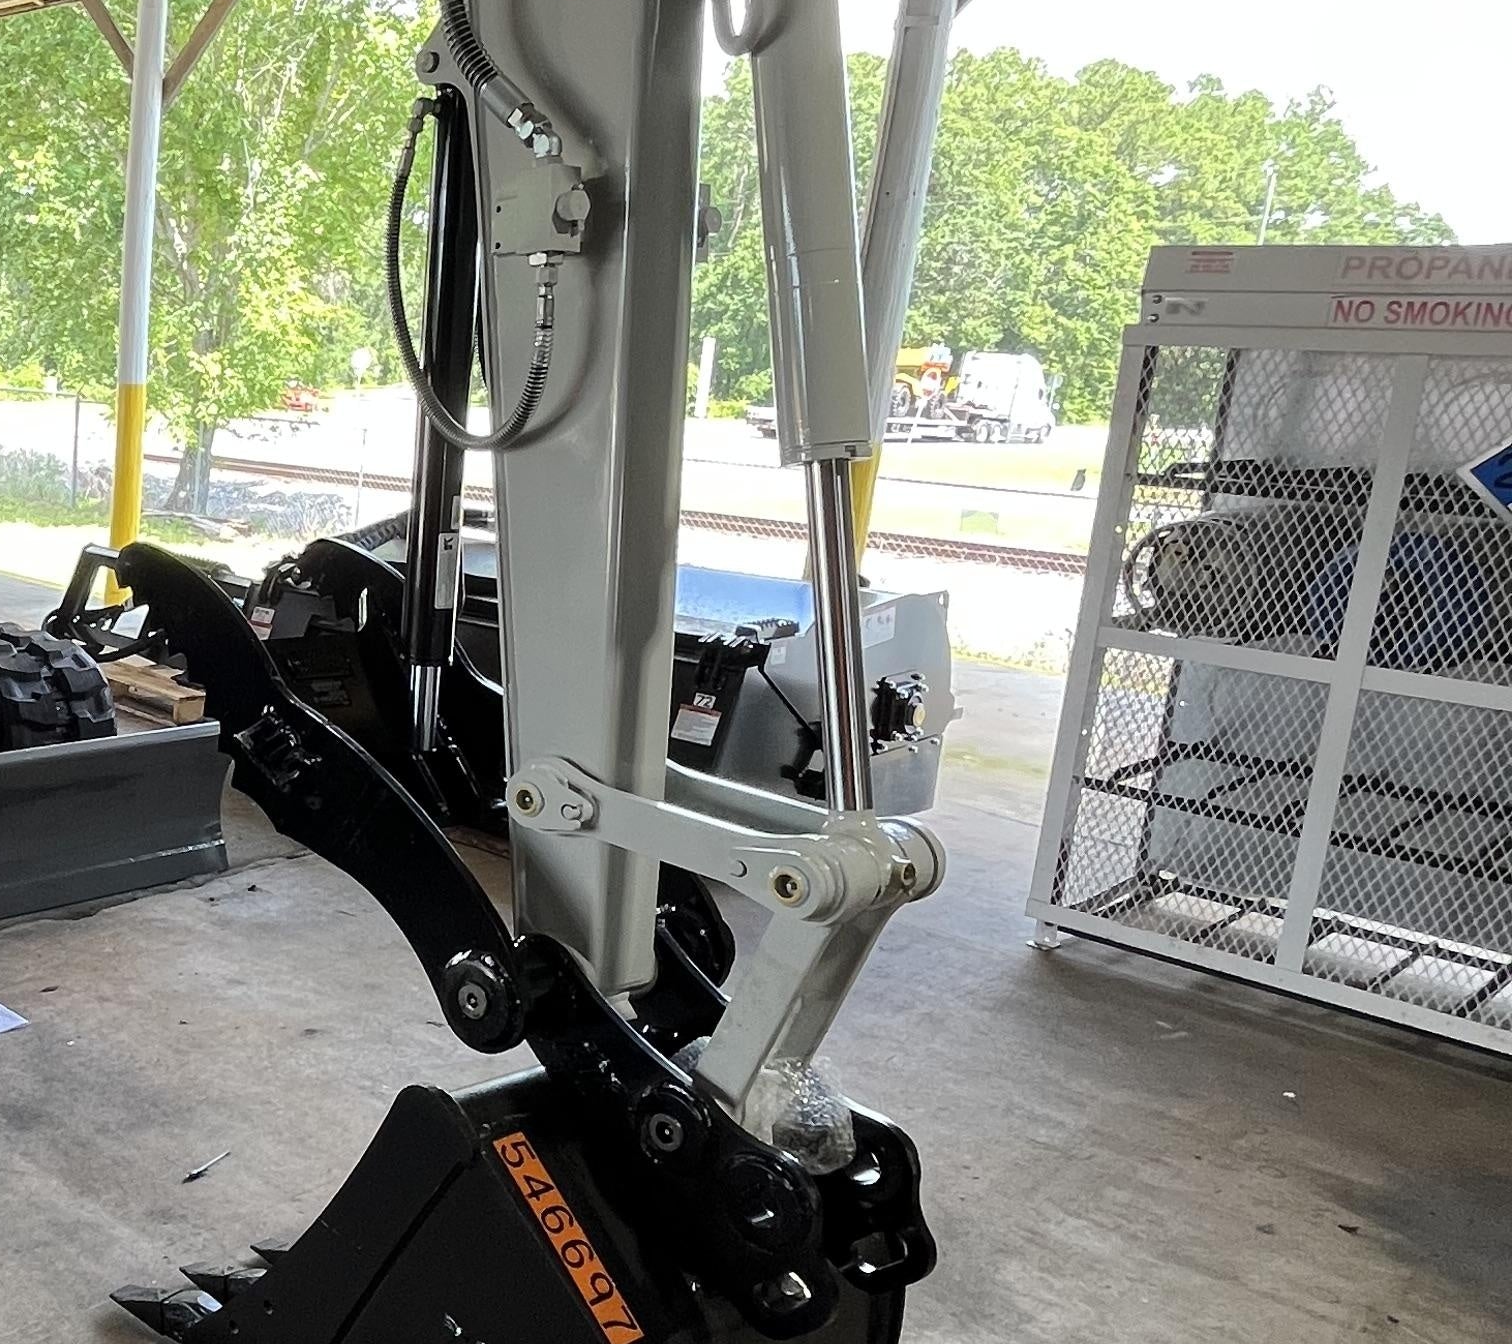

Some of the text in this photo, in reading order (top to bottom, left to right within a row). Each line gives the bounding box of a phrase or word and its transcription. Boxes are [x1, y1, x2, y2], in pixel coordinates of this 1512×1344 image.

[1340, 255, 1512, 281] PROPAN
[1332, 299, 1376, 324] NO
[696, 694, 714, 708] 72
[499, 1137, 638, 1340] 546697
